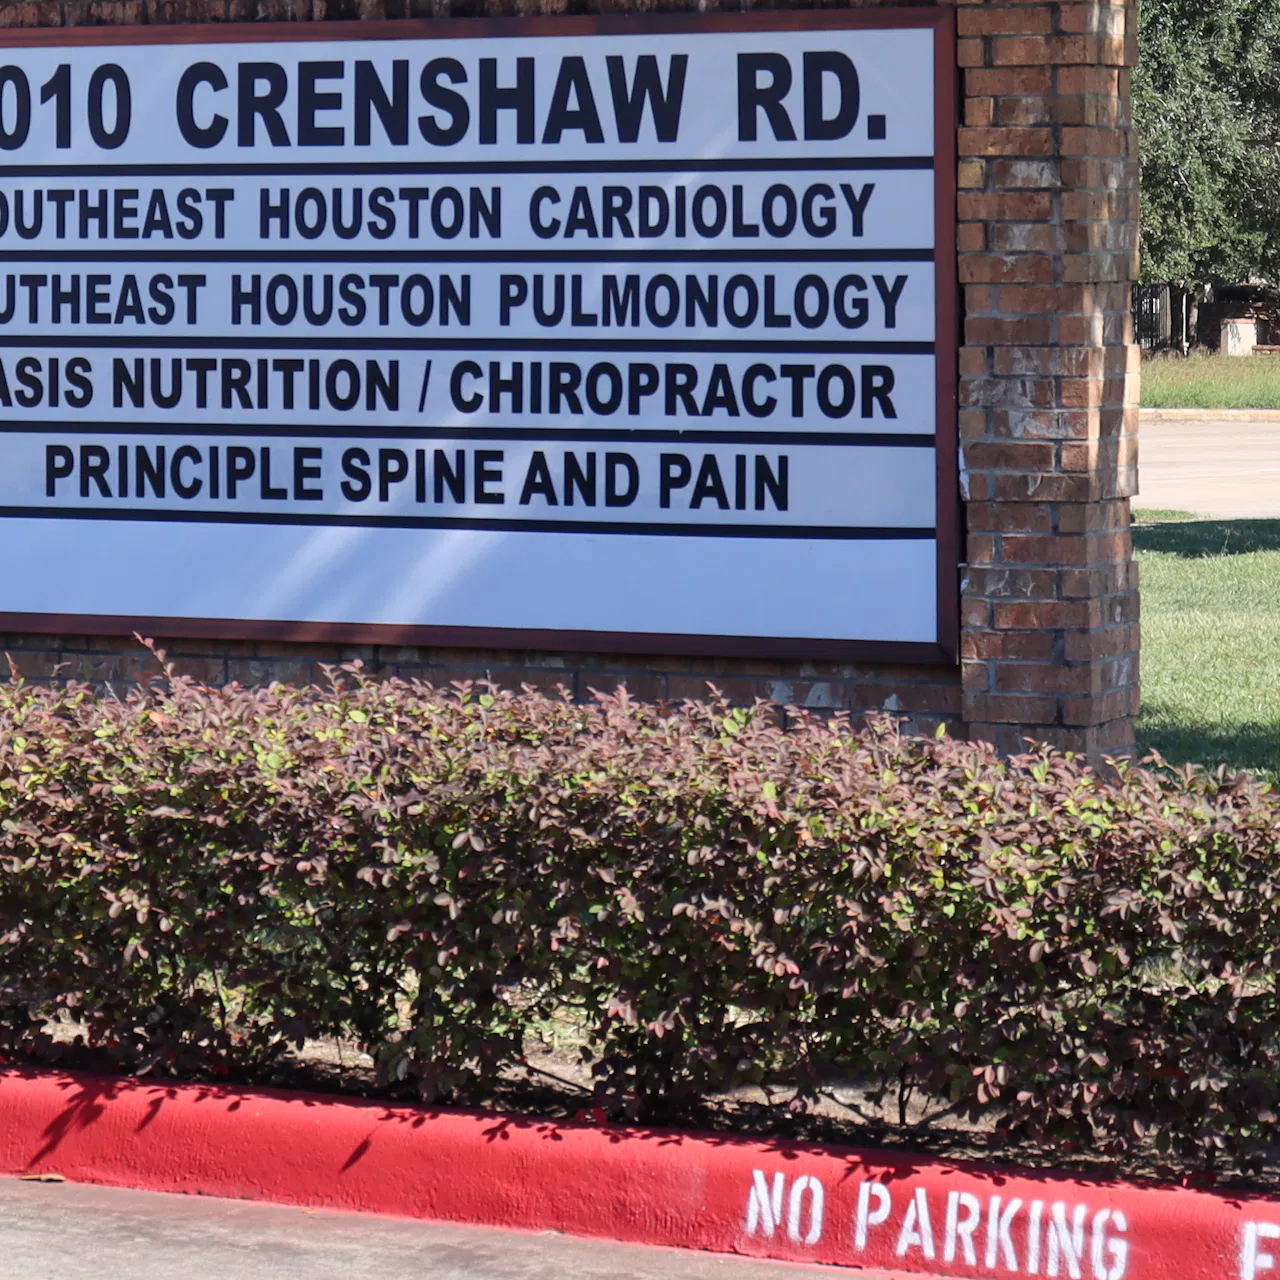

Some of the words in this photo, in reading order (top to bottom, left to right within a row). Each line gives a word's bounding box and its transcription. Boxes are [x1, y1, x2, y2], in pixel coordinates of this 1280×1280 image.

[176, 54, 688, 149] CRENSHAW
[737, 51, 886, 141] RD.
[259, 187, 502, 240] HOUSTON
[529, 183, 876, 239] CARDIOLOGY
[231, 274, 472, 327] HOUSTON
[500, 274, 908, 330] PULMONOLOGY
[112, 358, 400, 412] NUTRITION
[418, 360, 432, 412] /
[450, 360, 898, 419] CHIROPRACTOR
[46, 445, 323, 501] PRINCIPLE
[340, 447, 504, 505] SPINE
[519, 451, 639, 507] AND
[659, 453, 789, 511] PAIN
[746, 1169, 823, 1245] NO
[854, 1181, 1129, 1280] PARKING
